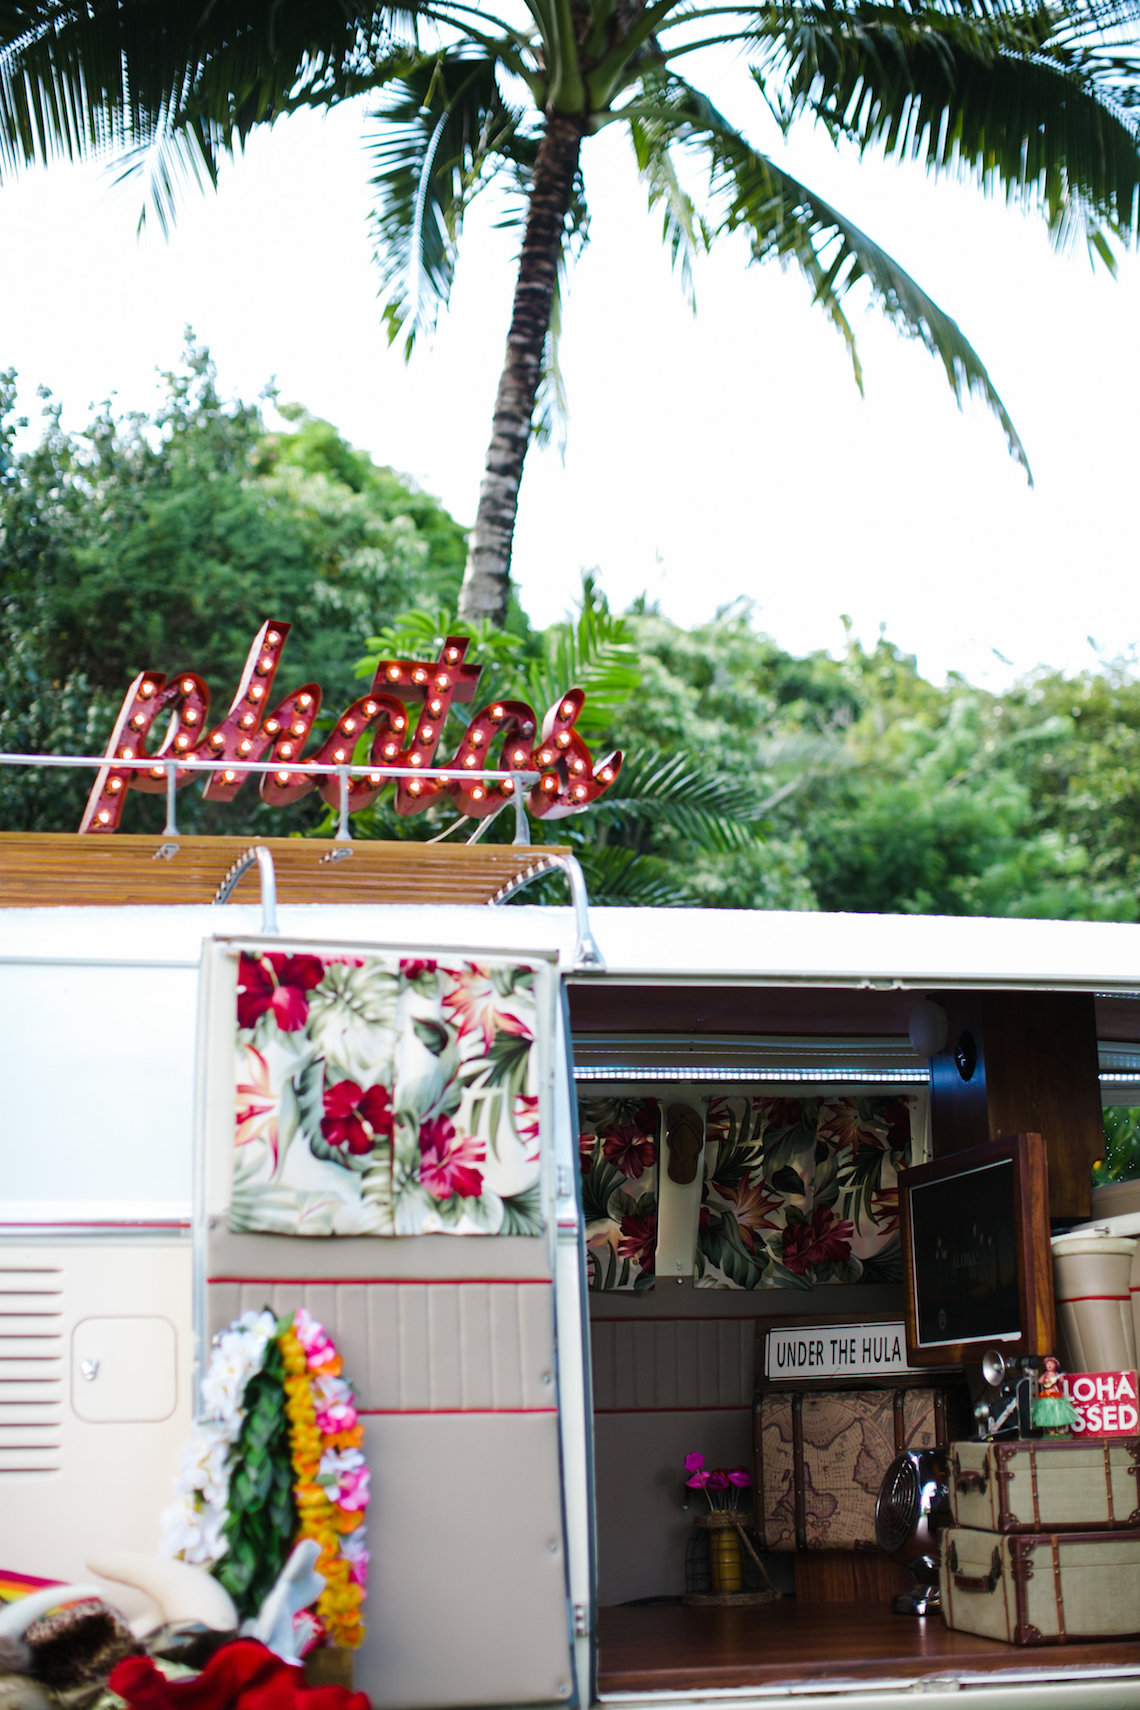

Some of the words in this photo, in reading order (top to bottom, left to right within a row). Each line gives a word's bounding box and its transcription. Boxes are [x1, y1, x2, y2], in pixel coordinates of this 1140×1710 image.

[79, 619, 623, 834] photos
[777, 1340, 824, 1368] UNDER
[830, 1338, 856, 1366] THE
[863, 1336, 902, 1363] HULA
[1062, 1374, 1136, 1402] LOHA
[1069, 1404, 1138, 1432] SSED
